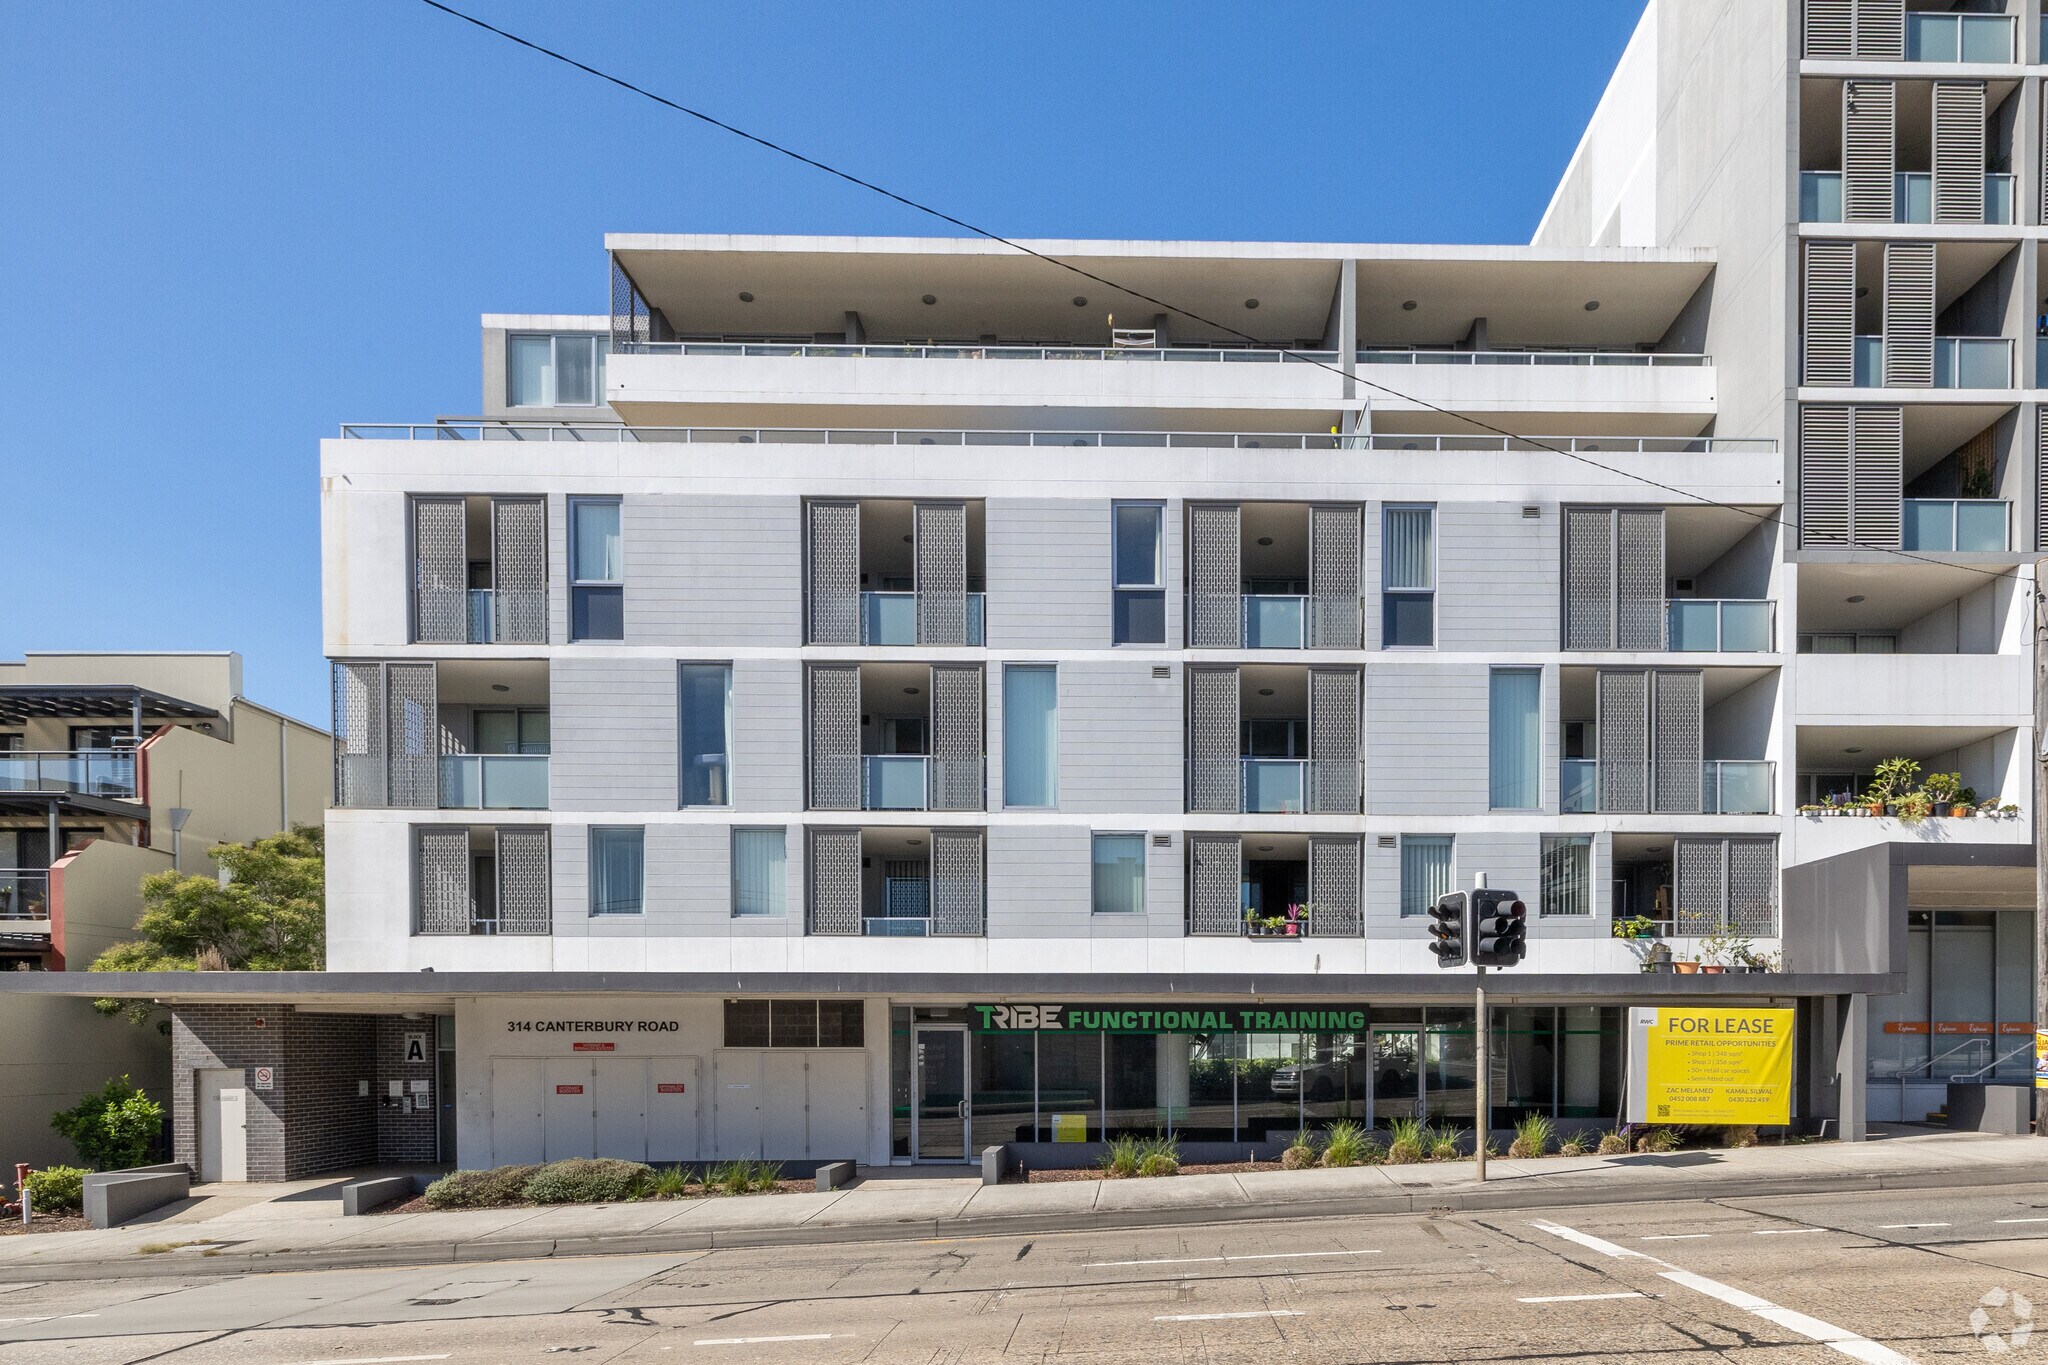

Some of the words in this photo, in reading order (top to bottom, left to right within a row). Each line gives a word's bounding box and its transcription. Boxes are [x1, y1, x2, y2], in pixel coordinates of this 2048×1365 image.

[974, 1005, 1063, 1029] TRIBE
[1068, 1011, 1233, 1029] FUNCTIONAL
[1239, 1011, 1365, 1029] TRAINING
[507, 1021, 532, 1032] 314
[535, 1021, 634, 1032] CANTERBURY
[637, 1021, 679, 1032] ROAD
[1669, 1017, 1710, 1033] FOR
[1714, 1018, 1774, 1034] LEASE
[1665, 1039, 1689, 1047] PRIME
[1690, 1039, 1716, 1047] RETAIL
[1716, 1040, 1777, 1048] OPPORTUNITIES
[407, 1040, 424, 1060] A
[1691, 1050, 1707, 1058] Shop
[1691, 1058, 1707, 1066] Shop
